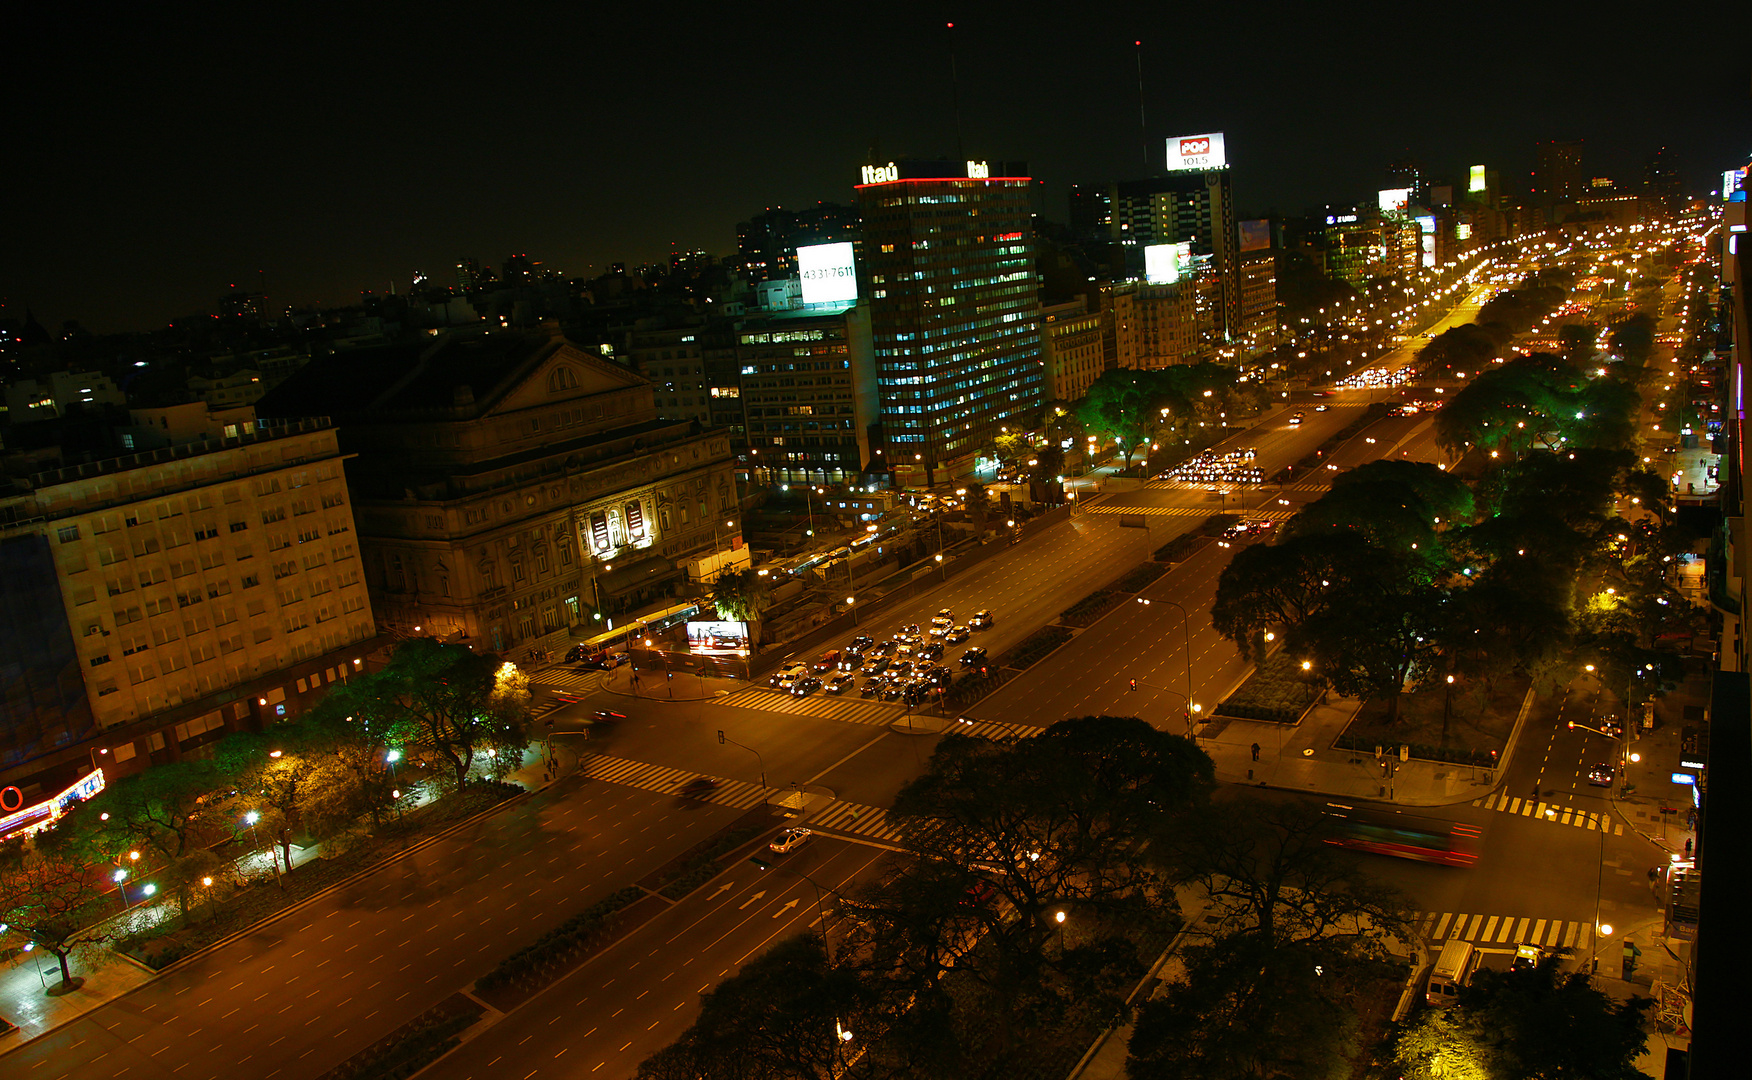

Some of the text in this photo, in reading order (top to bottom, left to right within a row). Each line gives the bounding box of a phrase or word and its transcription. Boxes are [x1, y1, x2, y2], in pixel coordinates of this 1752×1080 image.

[1182, 140, 1208, 154] POP
[1183, 156, 1208, 166] 101.5
[861, 161, 899, 185] Itaú
[966, 160, 989, 179] Itaú
[803, 266, 853, 280] 4331-7611
